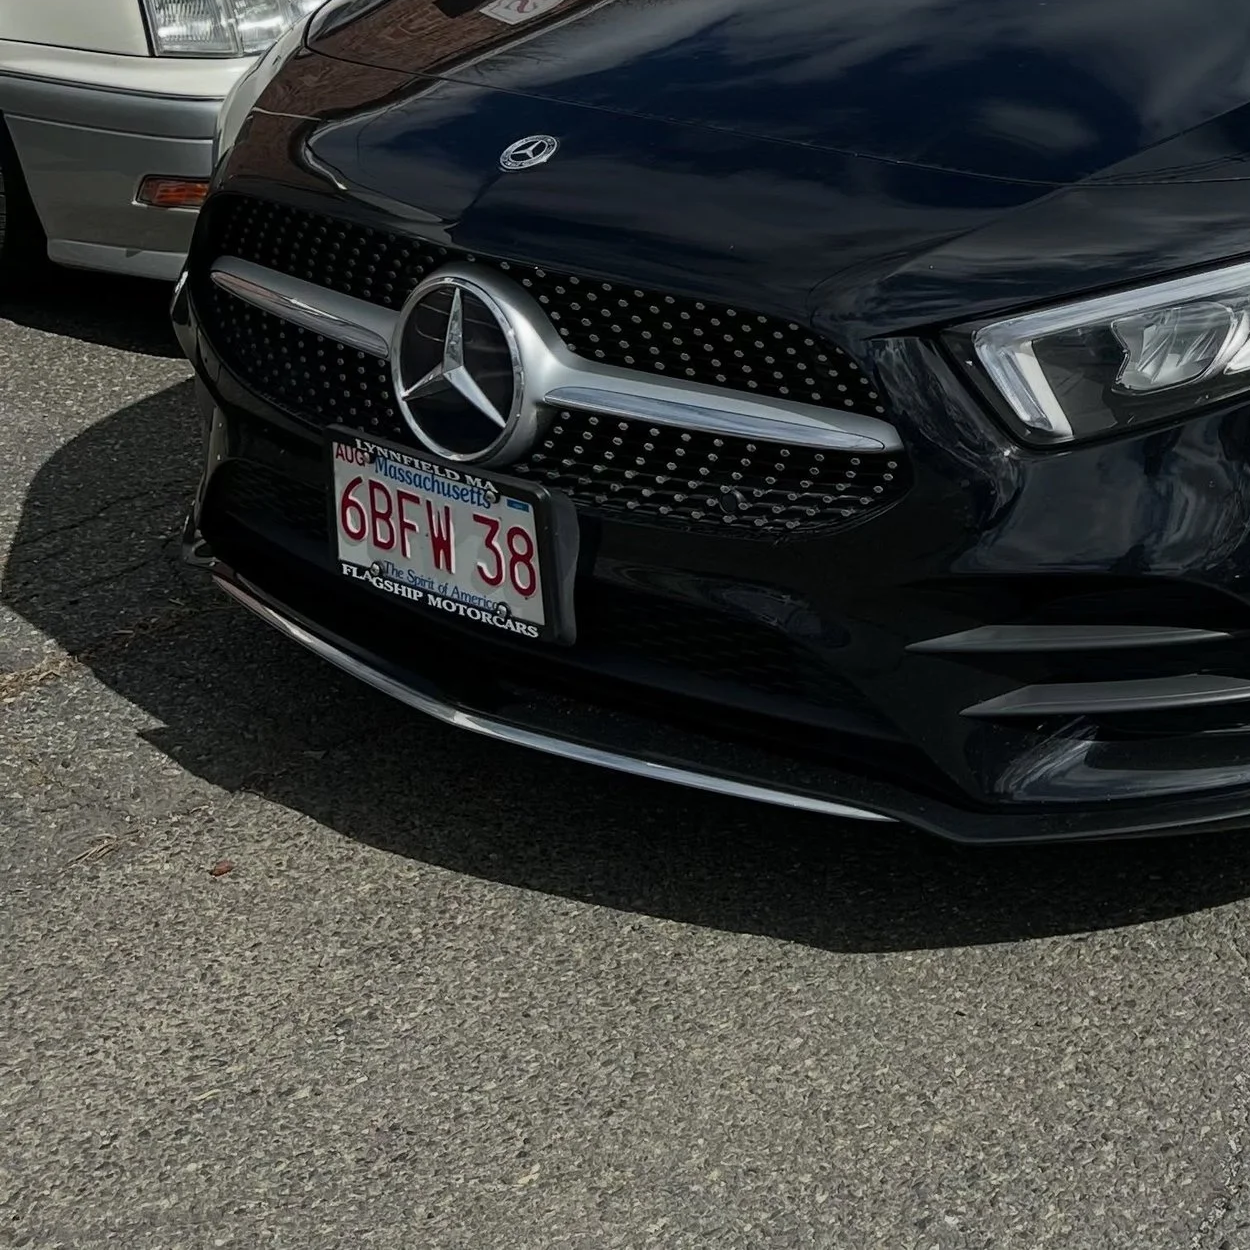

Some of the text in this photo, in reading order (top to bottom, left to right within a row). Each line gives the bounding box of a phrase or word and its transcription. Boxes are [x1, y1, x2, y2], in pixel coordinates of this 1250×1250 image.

[336, 443, 365, 467] AUG
[355, 438, 498, 494] LYNNFIELD MA
[375, 456, 491, 509] Massachusetts
[341, 476, 536, 597] 6BFW 38
[342, 563, 539, 639] FLAGSHIP MOTORCARS
[383, 560, 405, 580] The
[407, 569, 434, 592] Spirit
[437, 579, 448, 598] of
